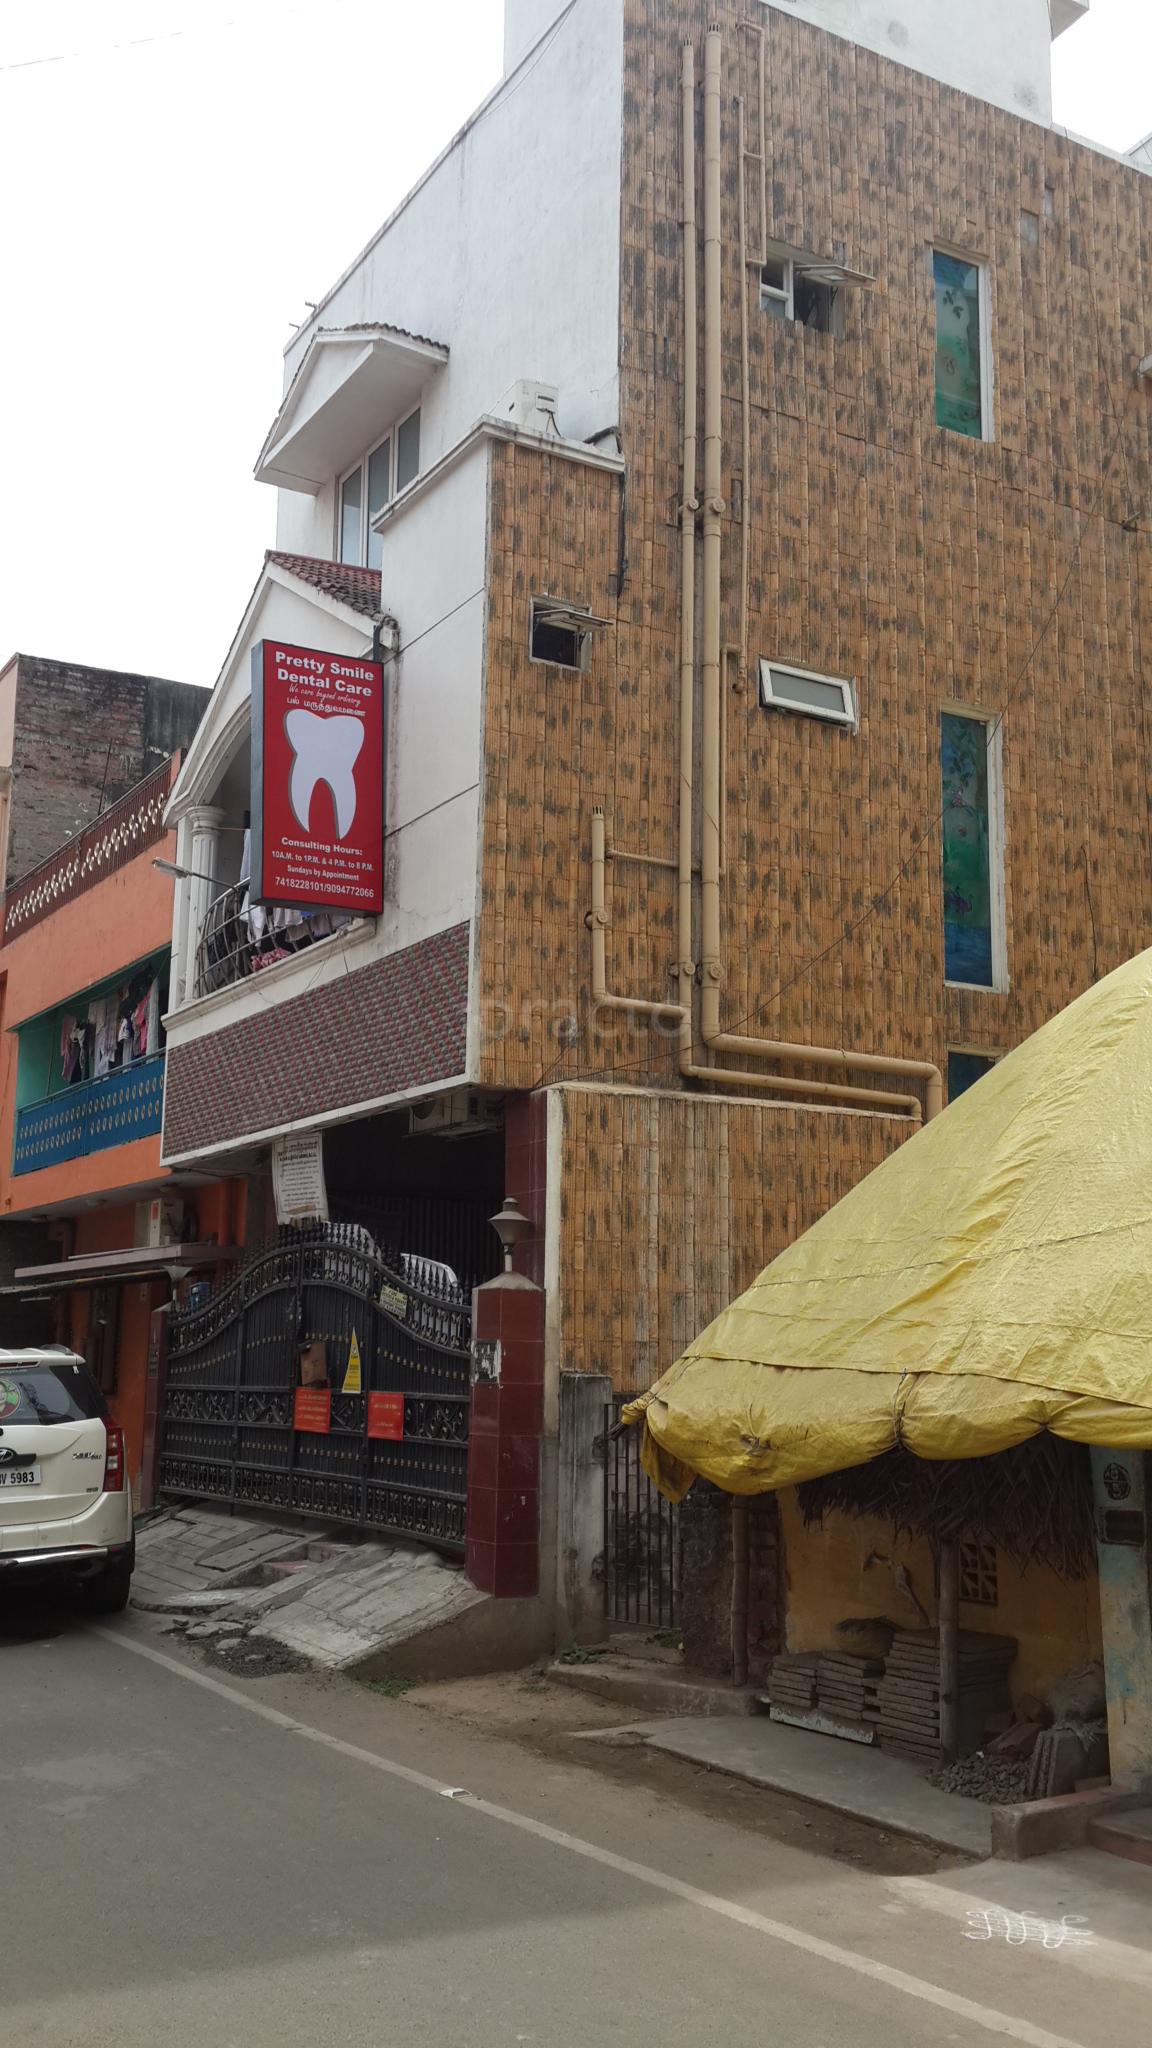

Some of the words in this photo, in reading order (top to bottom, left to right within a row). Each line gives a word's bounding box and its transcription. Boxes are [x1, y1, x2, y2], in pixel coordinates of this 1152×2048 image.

[275, 651, 325, 674] Pretty
[330, 662, 374, 681] Smile
[277, 668, 330, 689] Dental
[335, 679, 372, 697] Care
[289, 683, 299, 693] We
[281, 837, 331, 853] Consulting
[333, 844, 363, 856] Hours:
[295, 854, 302, 862] to
[348, 861, 355, 869] to
[287, 864, 313, 876] Sundays
[313, 869, 321, 878] by
[322, 869, 360, 881] Appointment
[275, 876, 375, 898] 7418228101/9094772066
[10, 1471, 35, 1485] 5983
